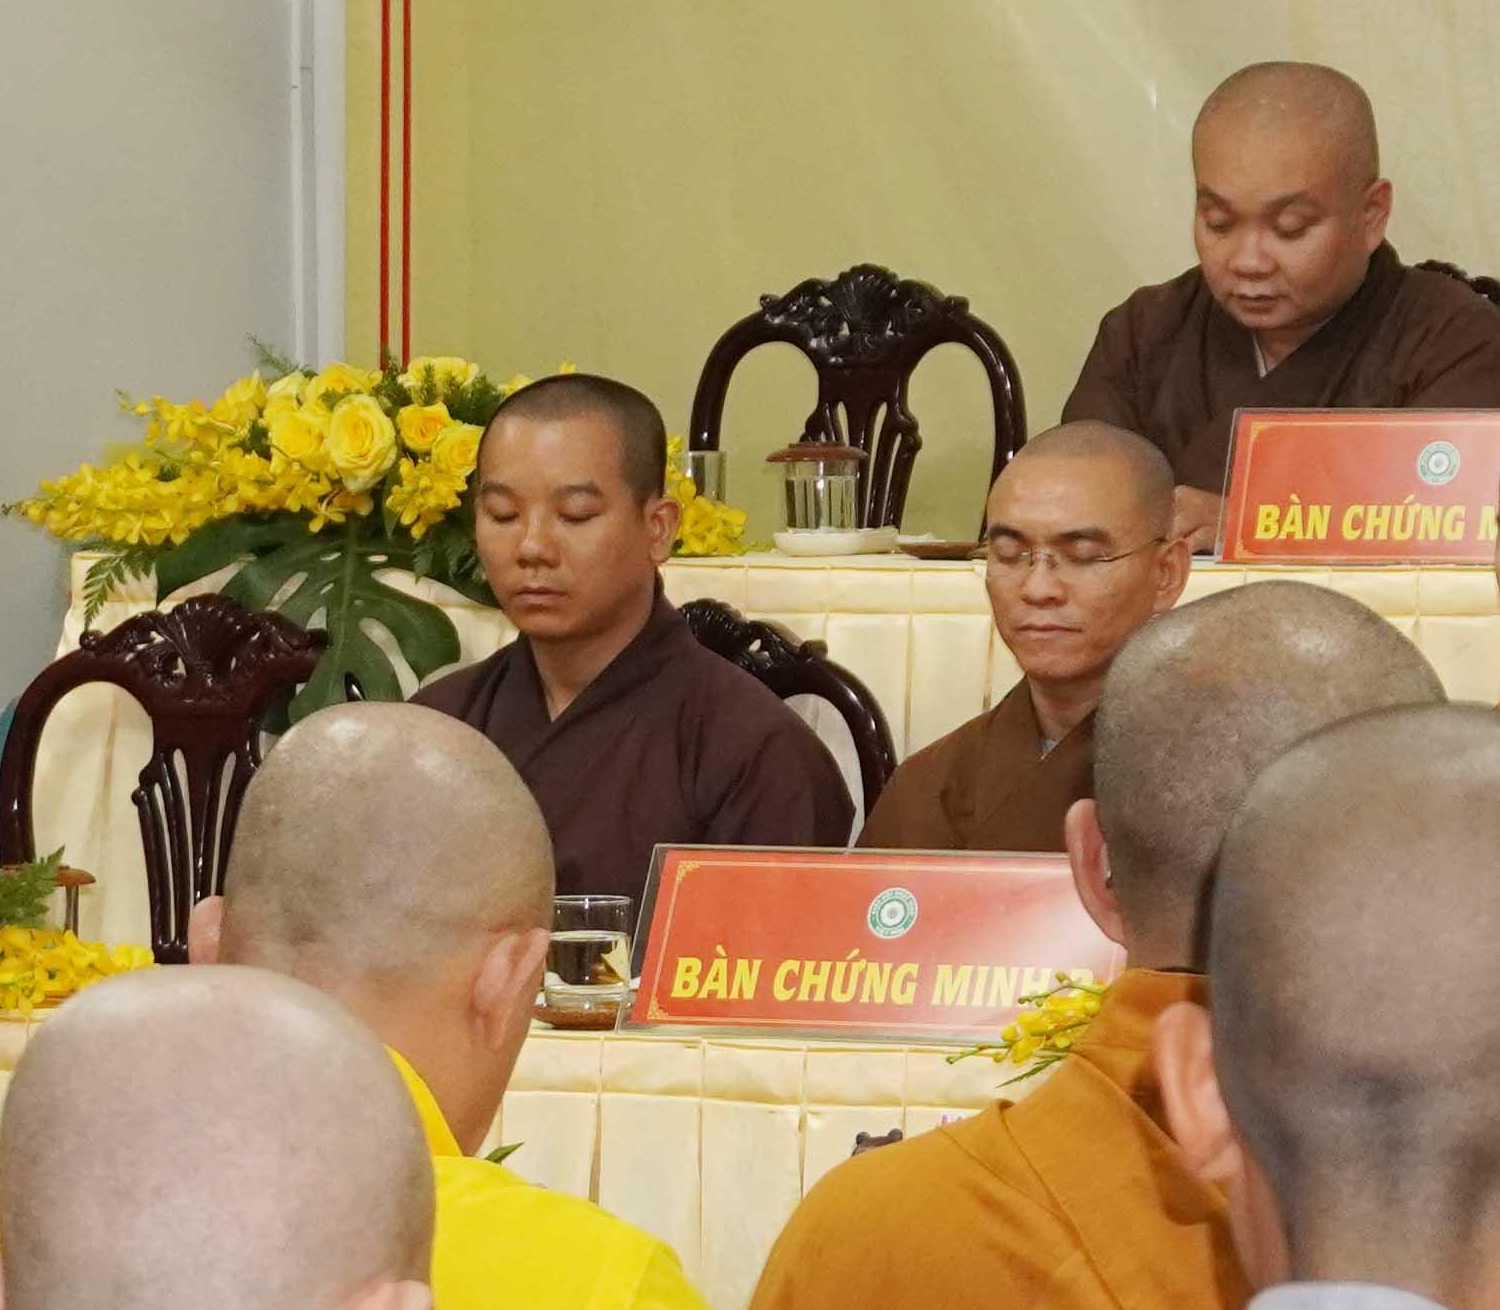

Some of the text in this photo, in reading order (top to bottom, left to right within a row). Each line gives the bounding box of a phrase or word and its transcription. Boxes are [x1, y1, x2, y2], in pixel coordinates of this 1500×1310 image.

[1255, 493, 1332, 541] BÀN
[1342, 493, 1467, 541] CHỨNG
[671, 944, 764, 1001] BÀN
[773, 947, 920, 1005] CHỨNG
[932, 964, 1053, 1008] MINH
